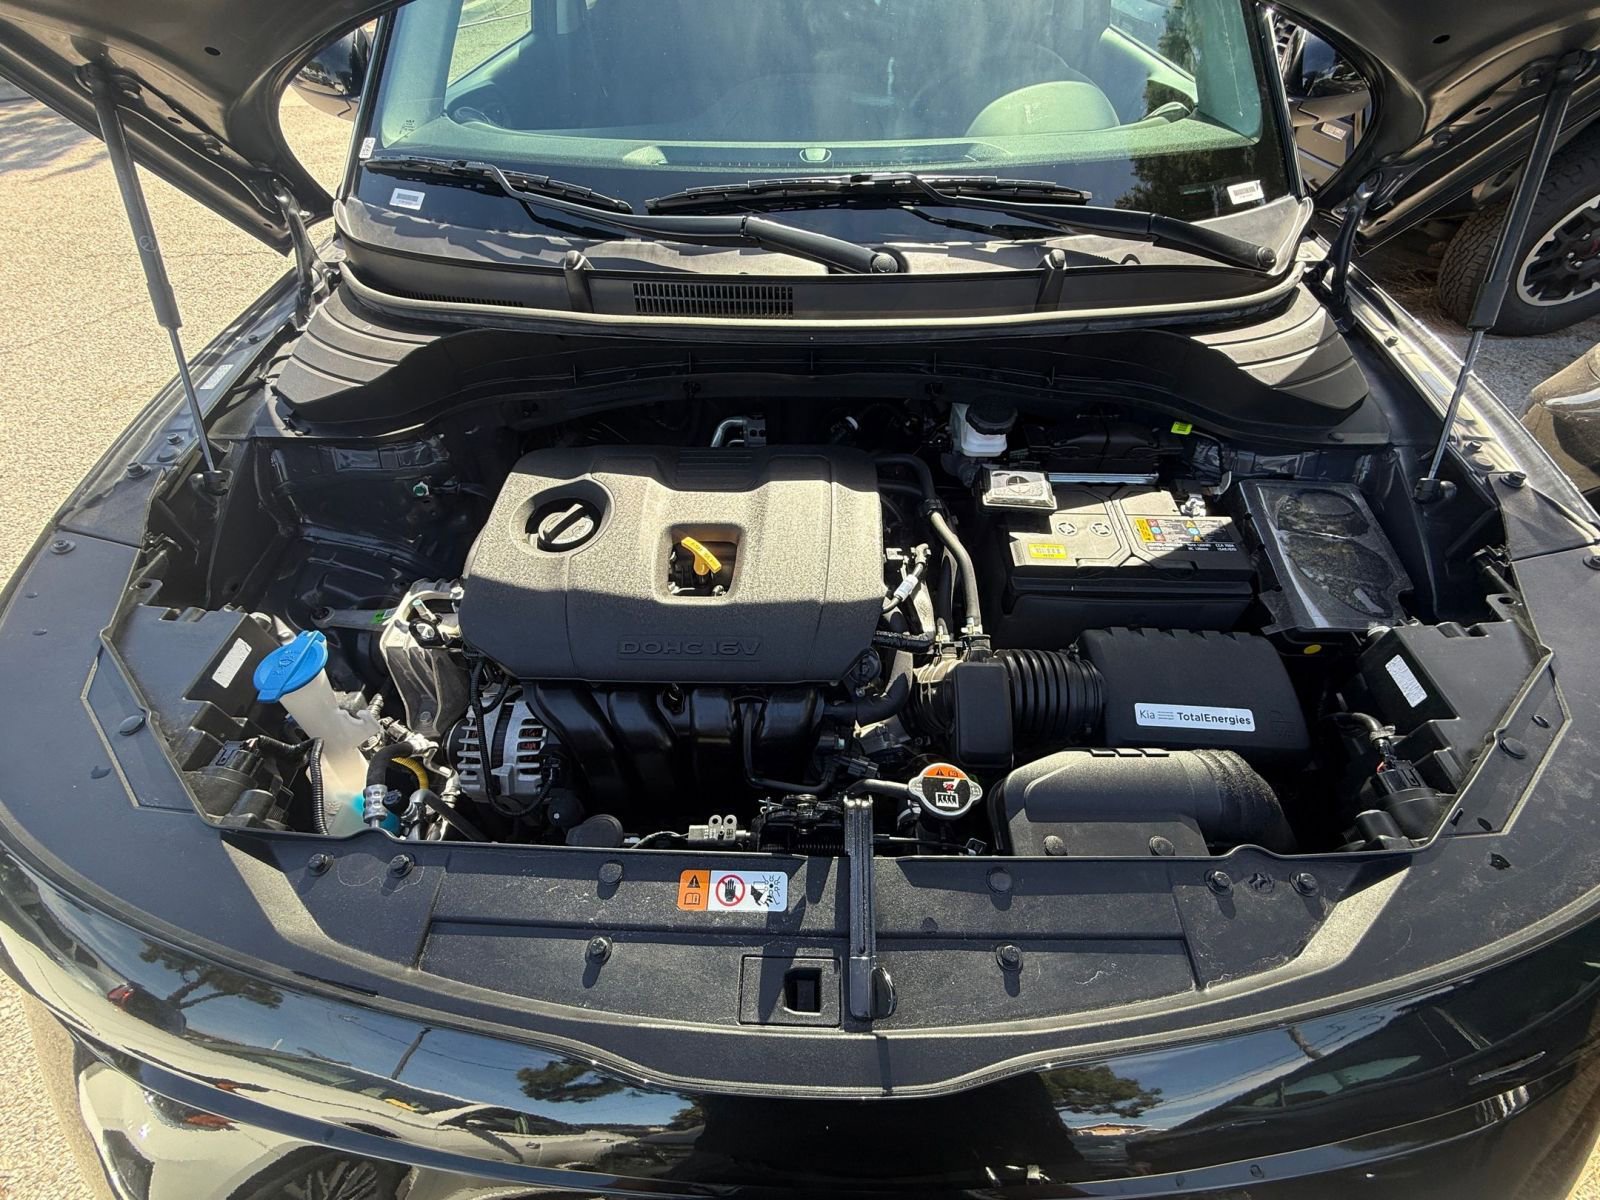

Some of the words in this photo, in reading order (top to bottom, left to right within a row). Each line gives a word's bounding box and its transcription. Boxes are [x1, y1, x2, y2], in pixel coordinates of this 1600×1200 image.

[620, 641, 704, 655] DOHC
[711, 642, 761, 656] 16V
[1139, 709, 1156, 720] Kia
[1177, 711, 1252, 725] TotalEnergies
